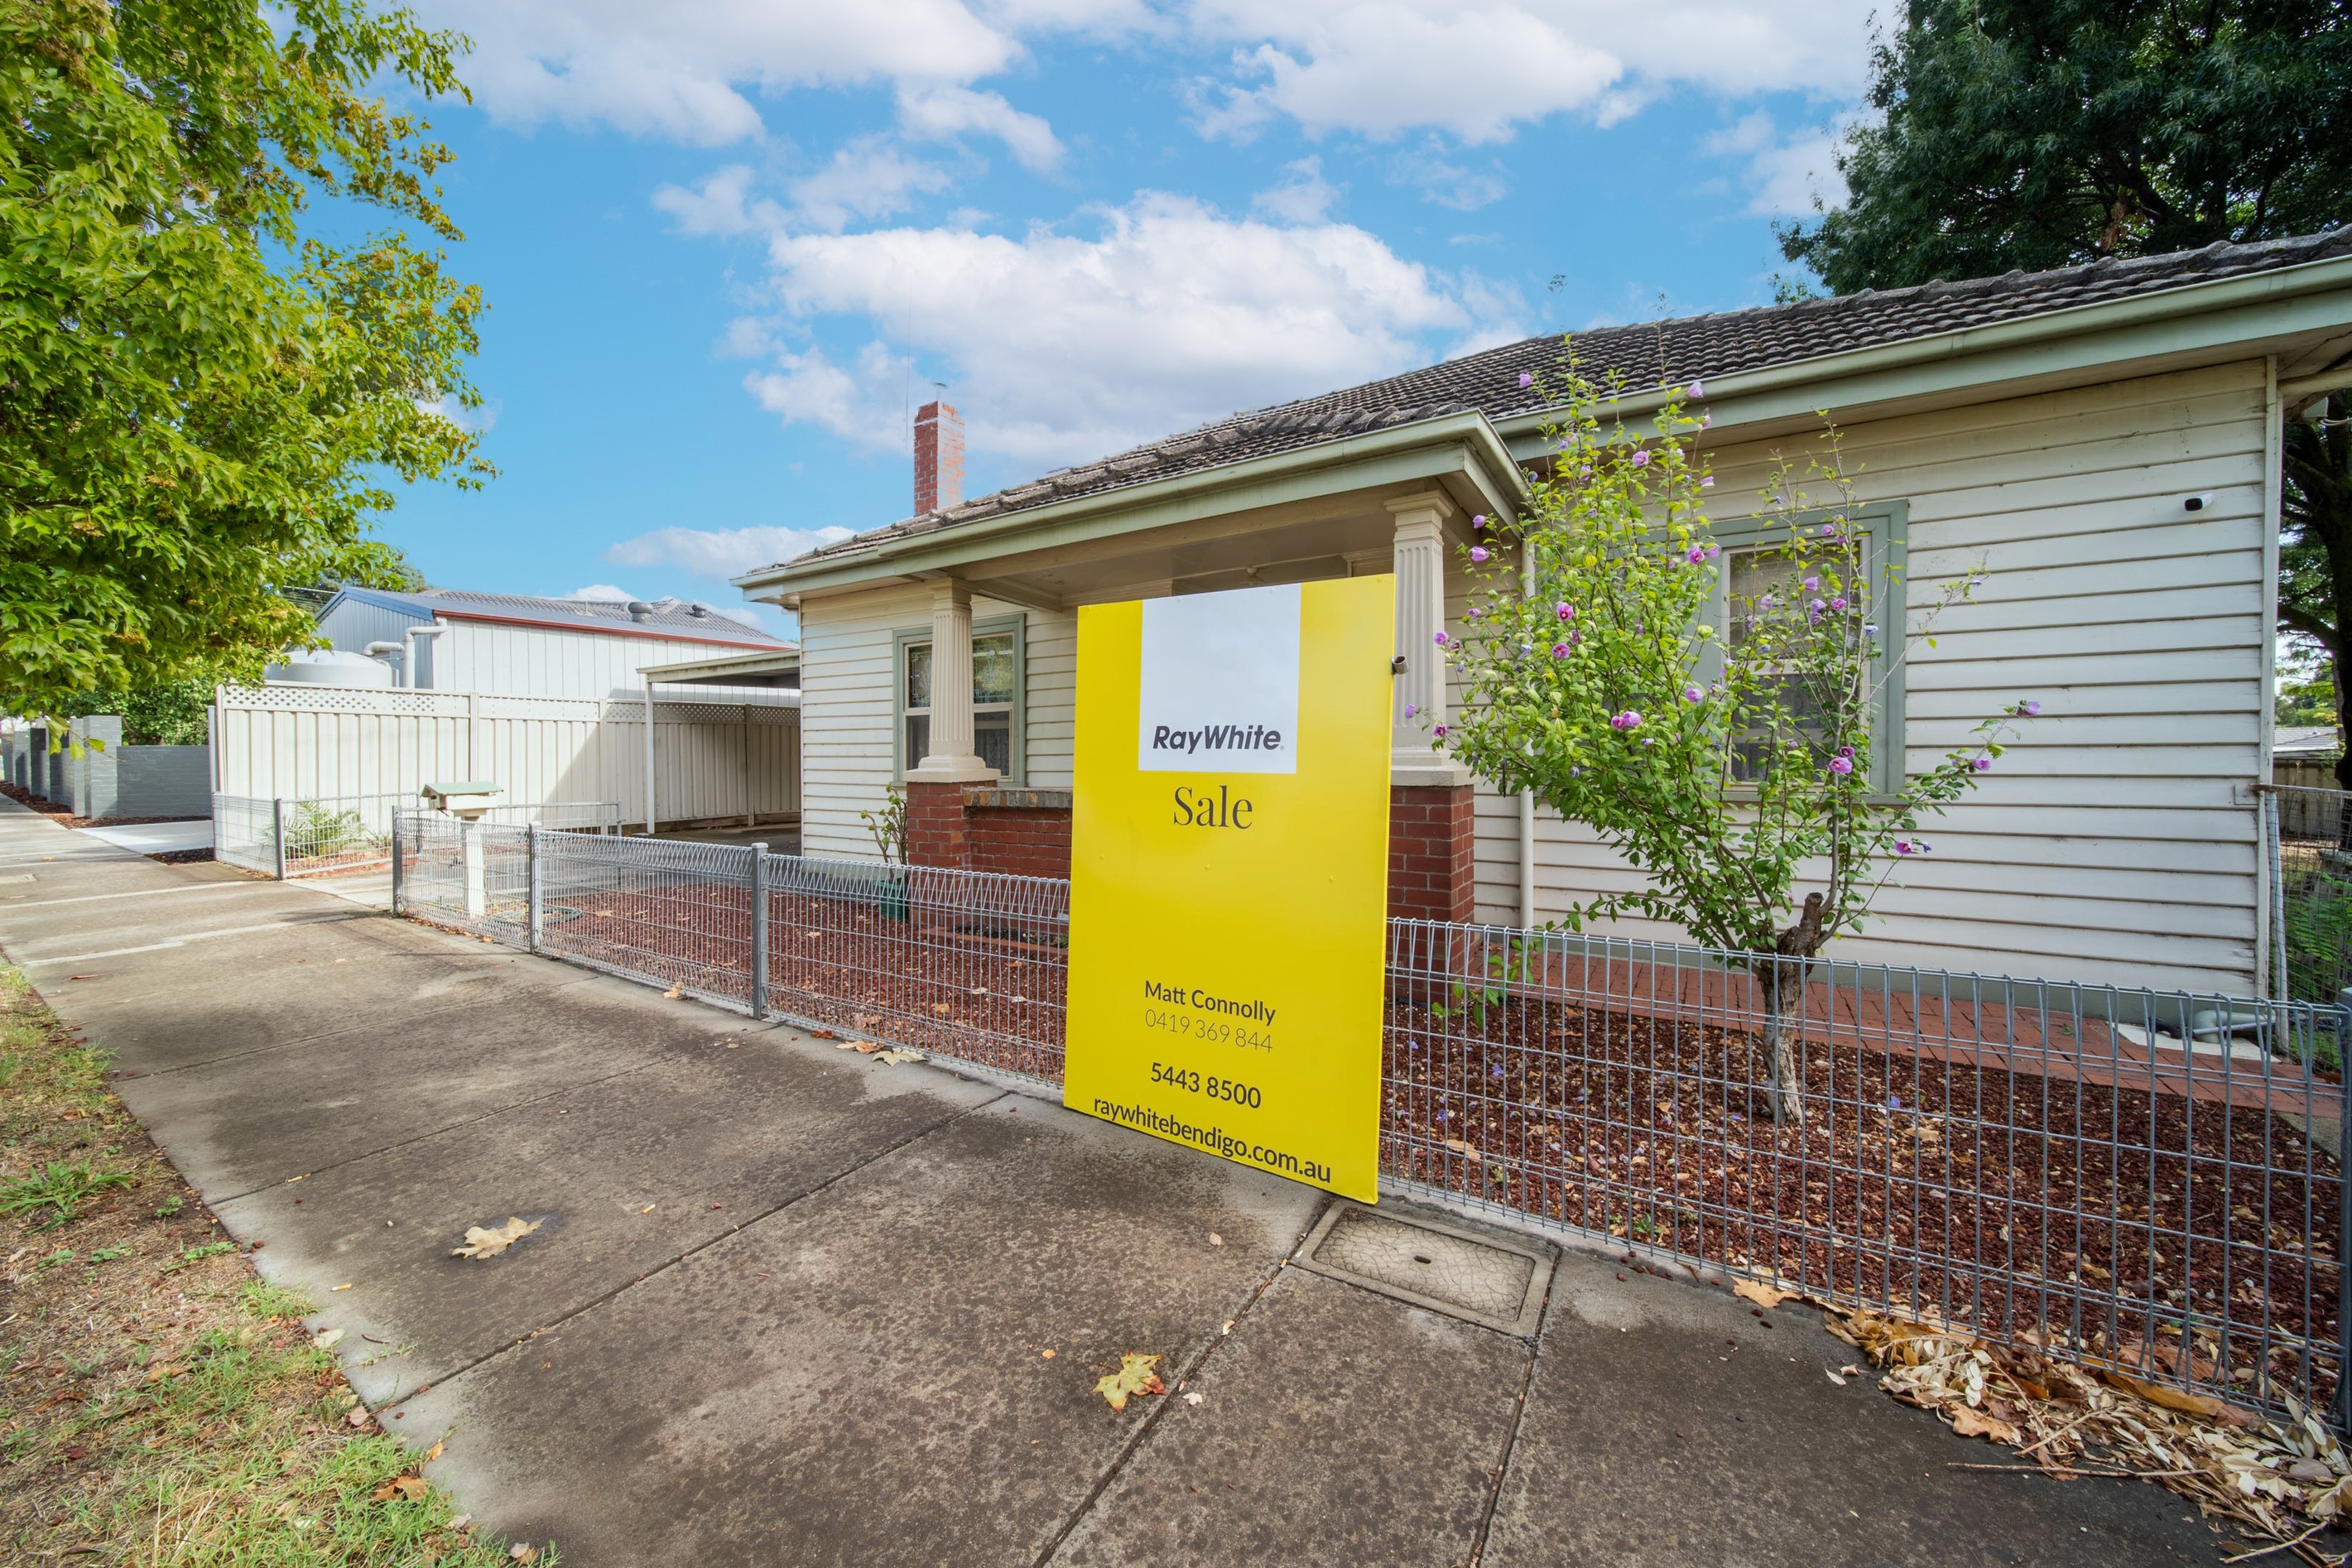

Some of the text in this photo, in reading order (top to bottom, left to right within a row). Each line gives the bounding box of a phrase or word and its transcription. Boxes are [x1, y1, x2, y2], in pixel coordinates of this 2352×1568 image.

[1173, 785, 1253, 830] Sale
[1145, 979, 1277, 1027] Matt Connolly
[1145, 1008, 1273, 1054] 0419 369 844
[1150, 1061, 1262, 1109] 5443 8500
[1094, 1097, 1331, 1184] raywhitebendigo.com.au
